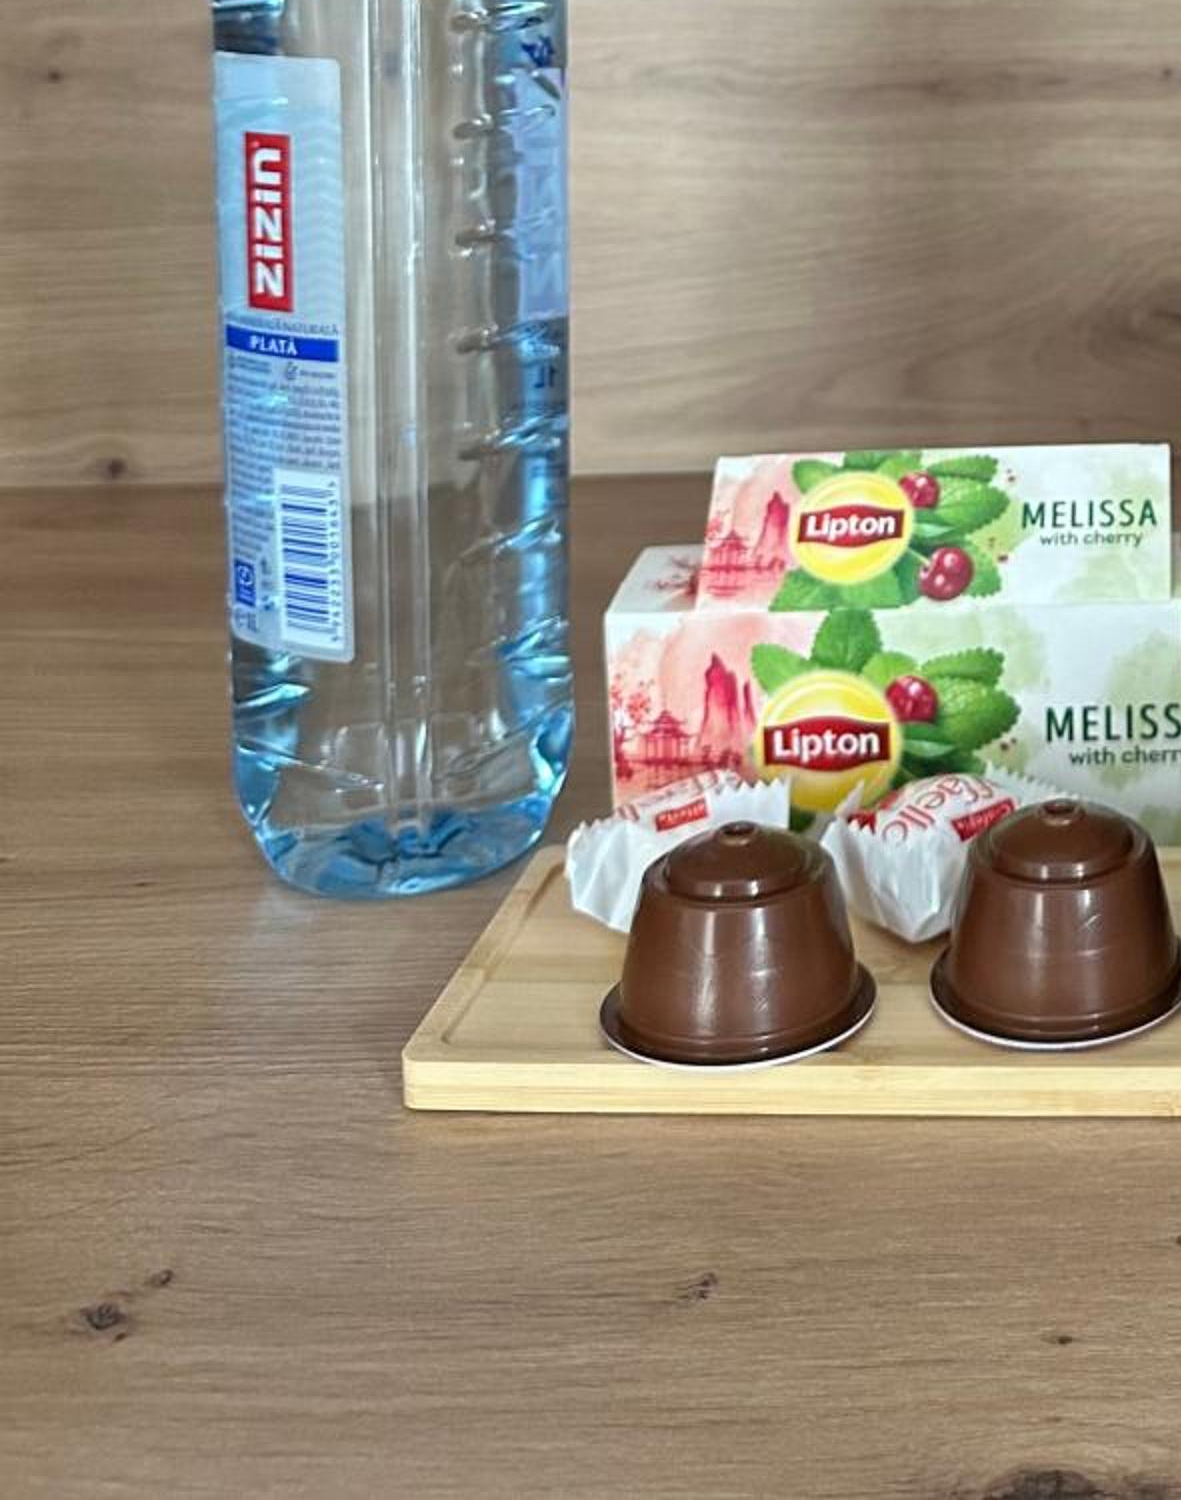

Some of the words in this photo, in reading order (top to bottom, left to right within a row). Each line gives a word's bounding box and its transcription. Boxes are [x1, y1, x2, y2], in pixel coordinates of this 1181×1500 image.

[806, 513, 895, 541] Lipton
[1022, 499, 1157, 529] MELISSA
[1040, 531, 1078, 546] with
[1083, 530, 1143, 548] cherry
[774, 728, 879, 762] Lipton
[1069, 746, 1116, 765] with
